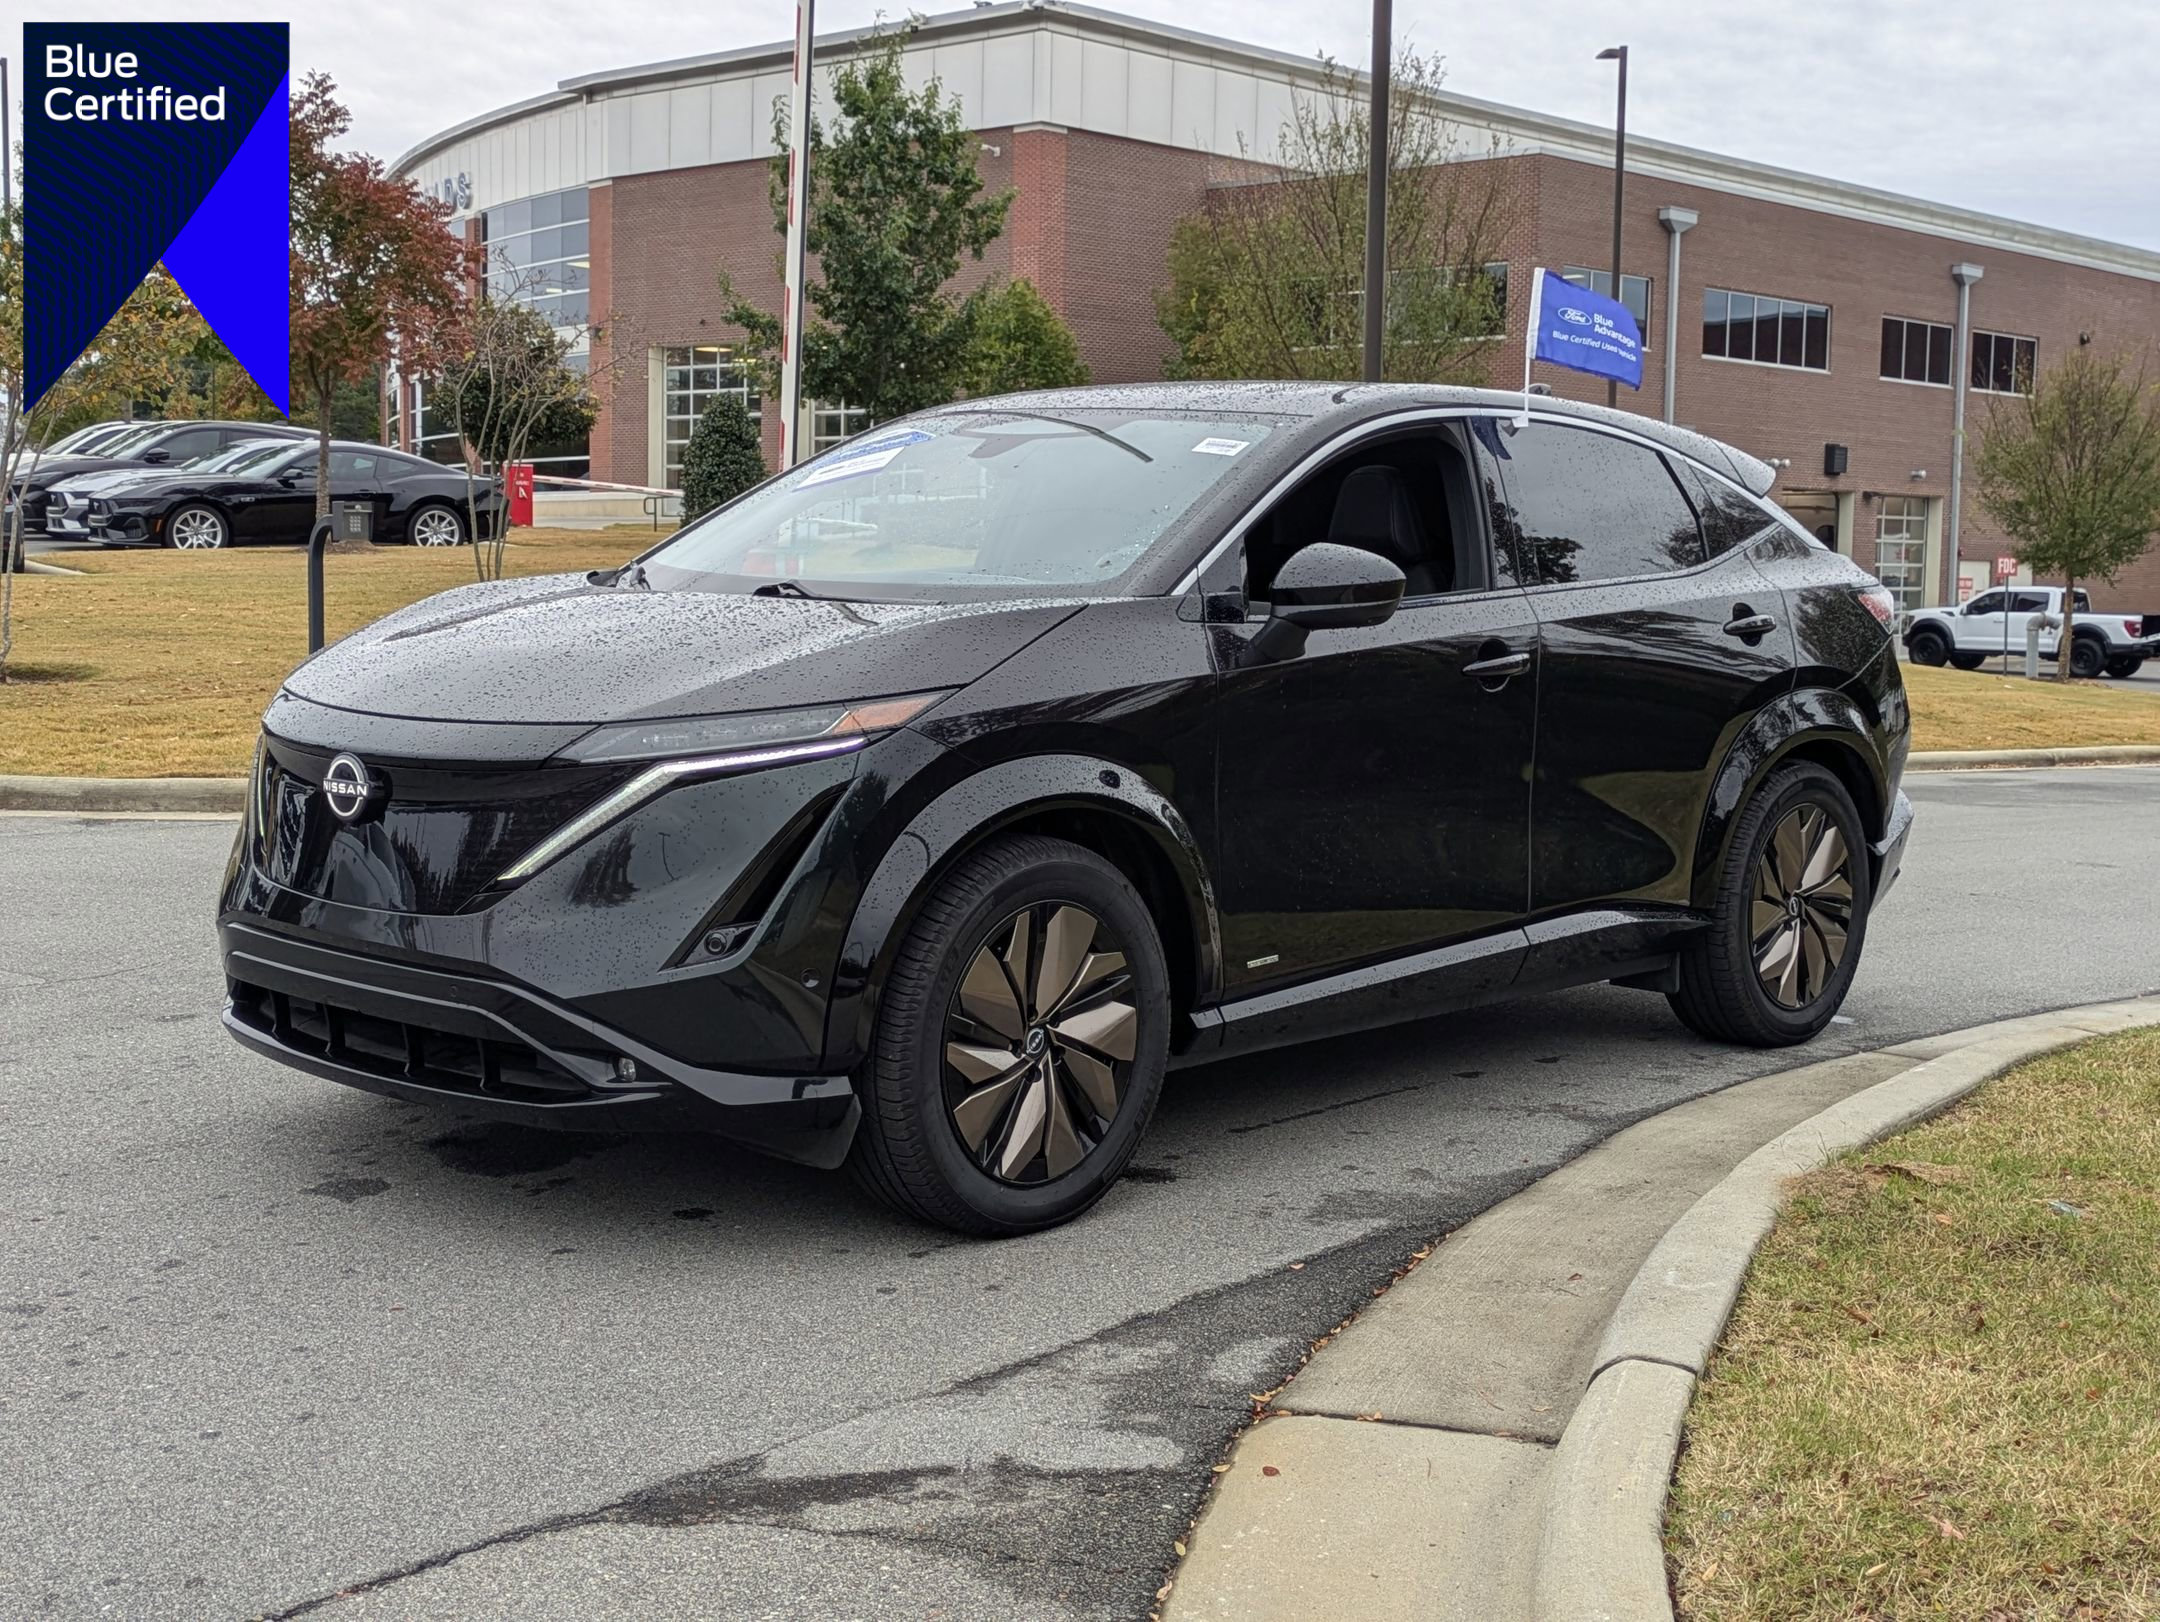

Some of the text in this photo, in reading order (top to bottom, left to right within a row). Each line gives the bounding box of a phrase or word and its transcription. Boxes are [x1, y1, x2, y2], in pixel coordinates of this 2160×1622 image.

[1593, 313, 1614, 328] Blue
[1552, 330, 1569, 341] Blue
[1570, 334, 1601, 348] Certified
[1594, 324, 1636, 348] Advantage
[1997, 557, 2016, 574] FDC
[323, 780, 367, 796] NISSAN
